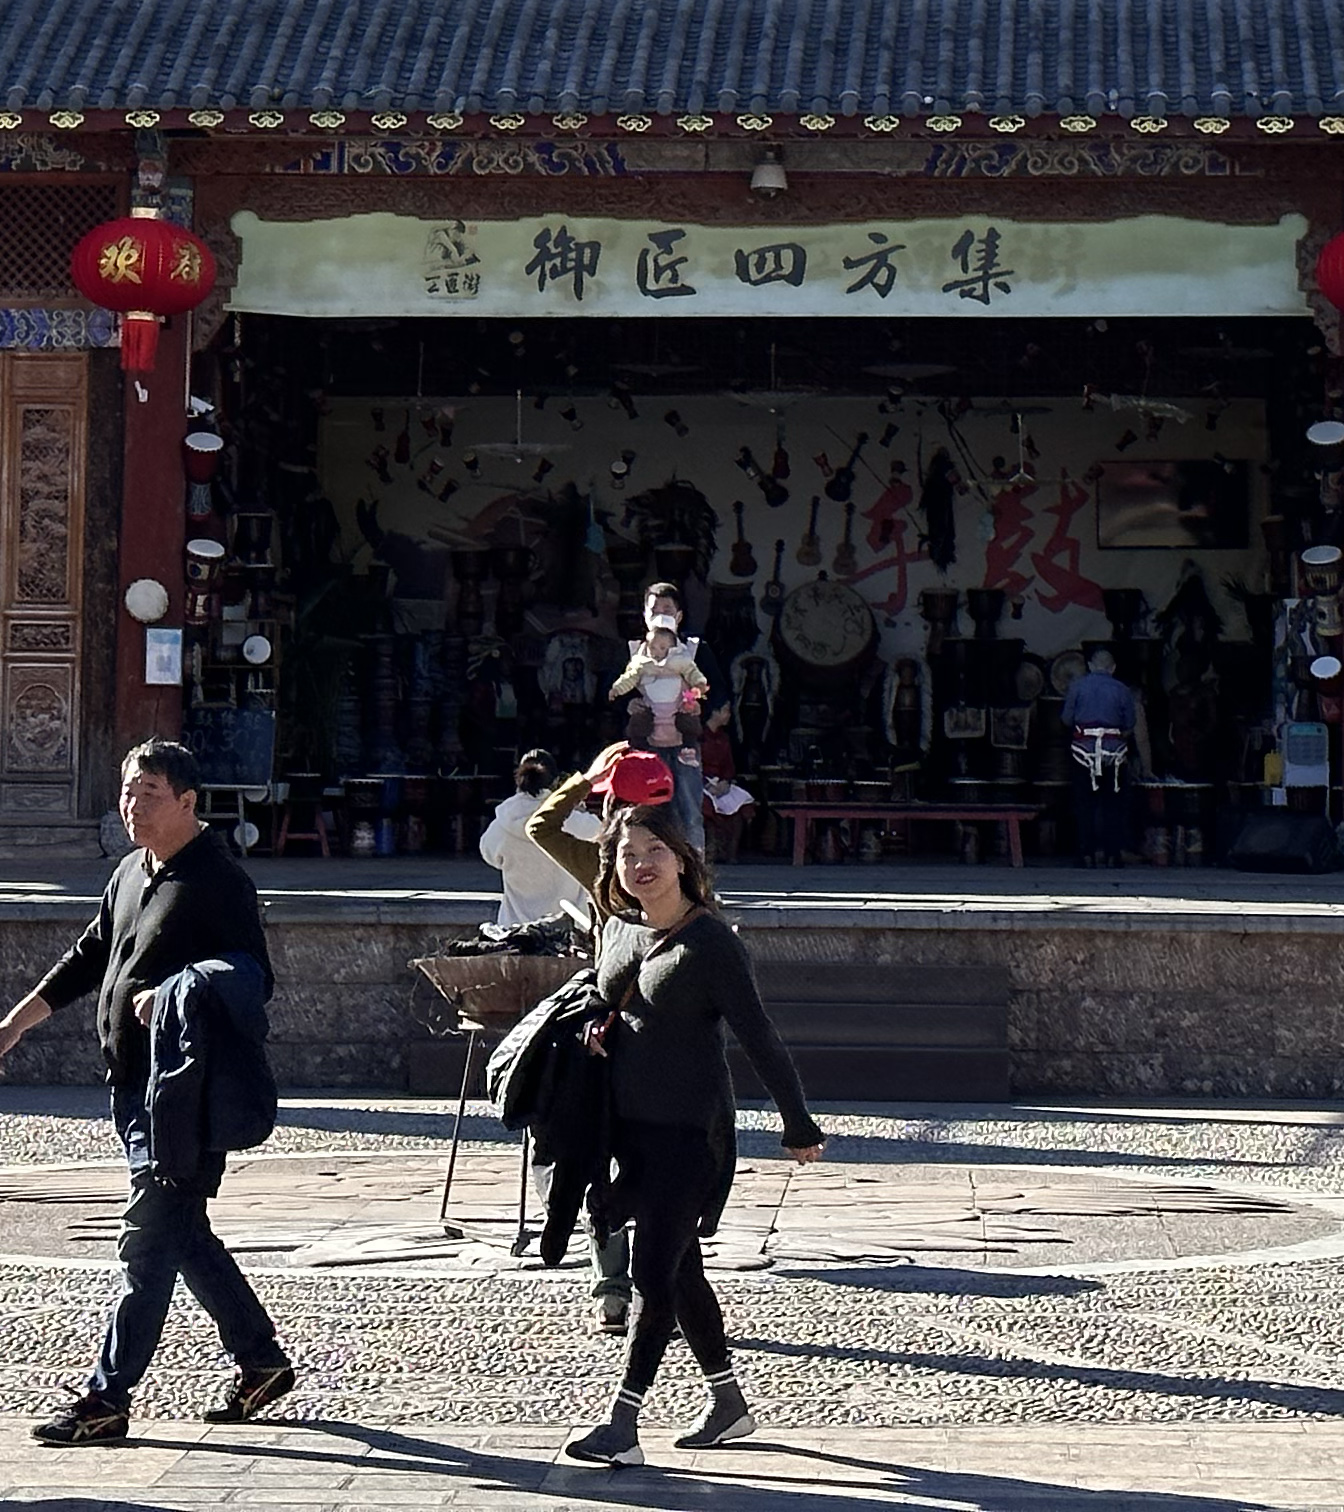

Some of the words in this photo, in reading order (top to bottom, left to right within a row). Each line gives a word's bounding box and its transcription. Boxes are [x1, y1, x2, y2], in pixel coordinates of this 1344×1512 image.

[524, 222, 1017, 307] 御匠四方集
